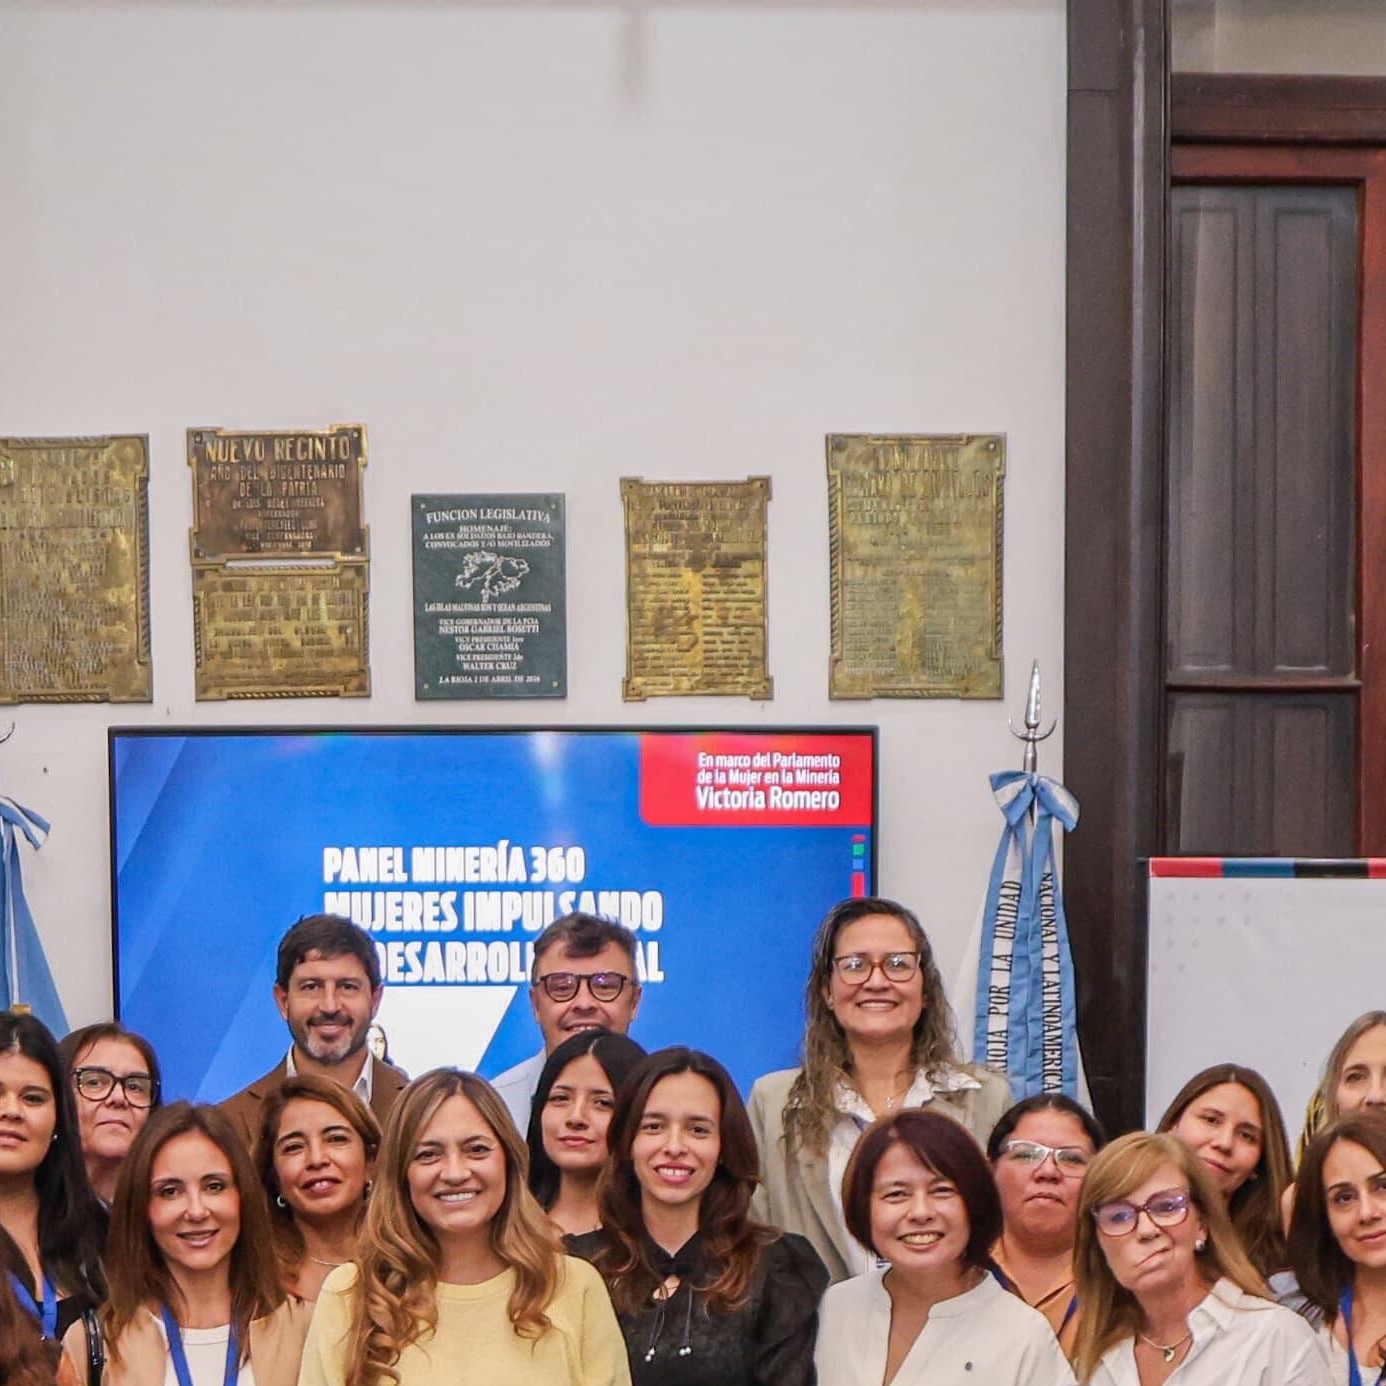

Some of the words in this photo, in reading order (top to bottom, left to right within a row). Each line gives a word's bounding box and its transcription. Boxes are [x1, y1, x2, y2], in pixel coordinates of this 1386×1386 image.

[206, 438, 265, 462] NUEVO
[275, 437, 349, 461] RECINTO
[241, 464, 259, 480] DEL
[270, 464, 345, 480] BICENTENARIO
[240, 481, 250, 496] DE
[261, 481, 272, 496] LA
[283, 481, 317, 496] PATRIA
[426, 509, 477, 523] FUNCION
[481, 509, 550, 523] LEGISLATIVA
[460, 525, 512, 533] HOMENAJE:
[425, 603, 436, 612] LAS
[439, 625, 469, 634] NESTOR
[471, 625, 506, 633] GABRIEL
[459, 643, 486, 651] OSCAR
[463, 662, 493, 670] WALTER
[496, 662, 517, 670] CRUZ
[698, 752, 713, 767] En
[716, 754, 751, 767] marco
[753, 753, 771, 767] del
[773, 752, 840, 767] Parlamento
[697, 769, 712, 784] de
[715, 770, 726, 784] la
[729, 769, 763, 787] Mujer
[764, 772, 779, 784] en
[782, 769, 794, 784] la
[795, 769, 840, 784] Minería
[696, 786, 766, 809] Victoria
[770, 787, 840, 809] Romero
[324, 847, 408, 883] PANEL
[412, 840, 527, 883] MINERÍA
[531, 847, 585, 883] 360
[324, 891, 458, 932] MUJERES
[993, 880, 1023, 940] UNIDAD
[1039, 872, 1059, 949] NACIONAL
[989, 954, 1013, 973] LA
[1042, 953, 1061, 964] Y
[987, 985, 1011, 1016] POR
